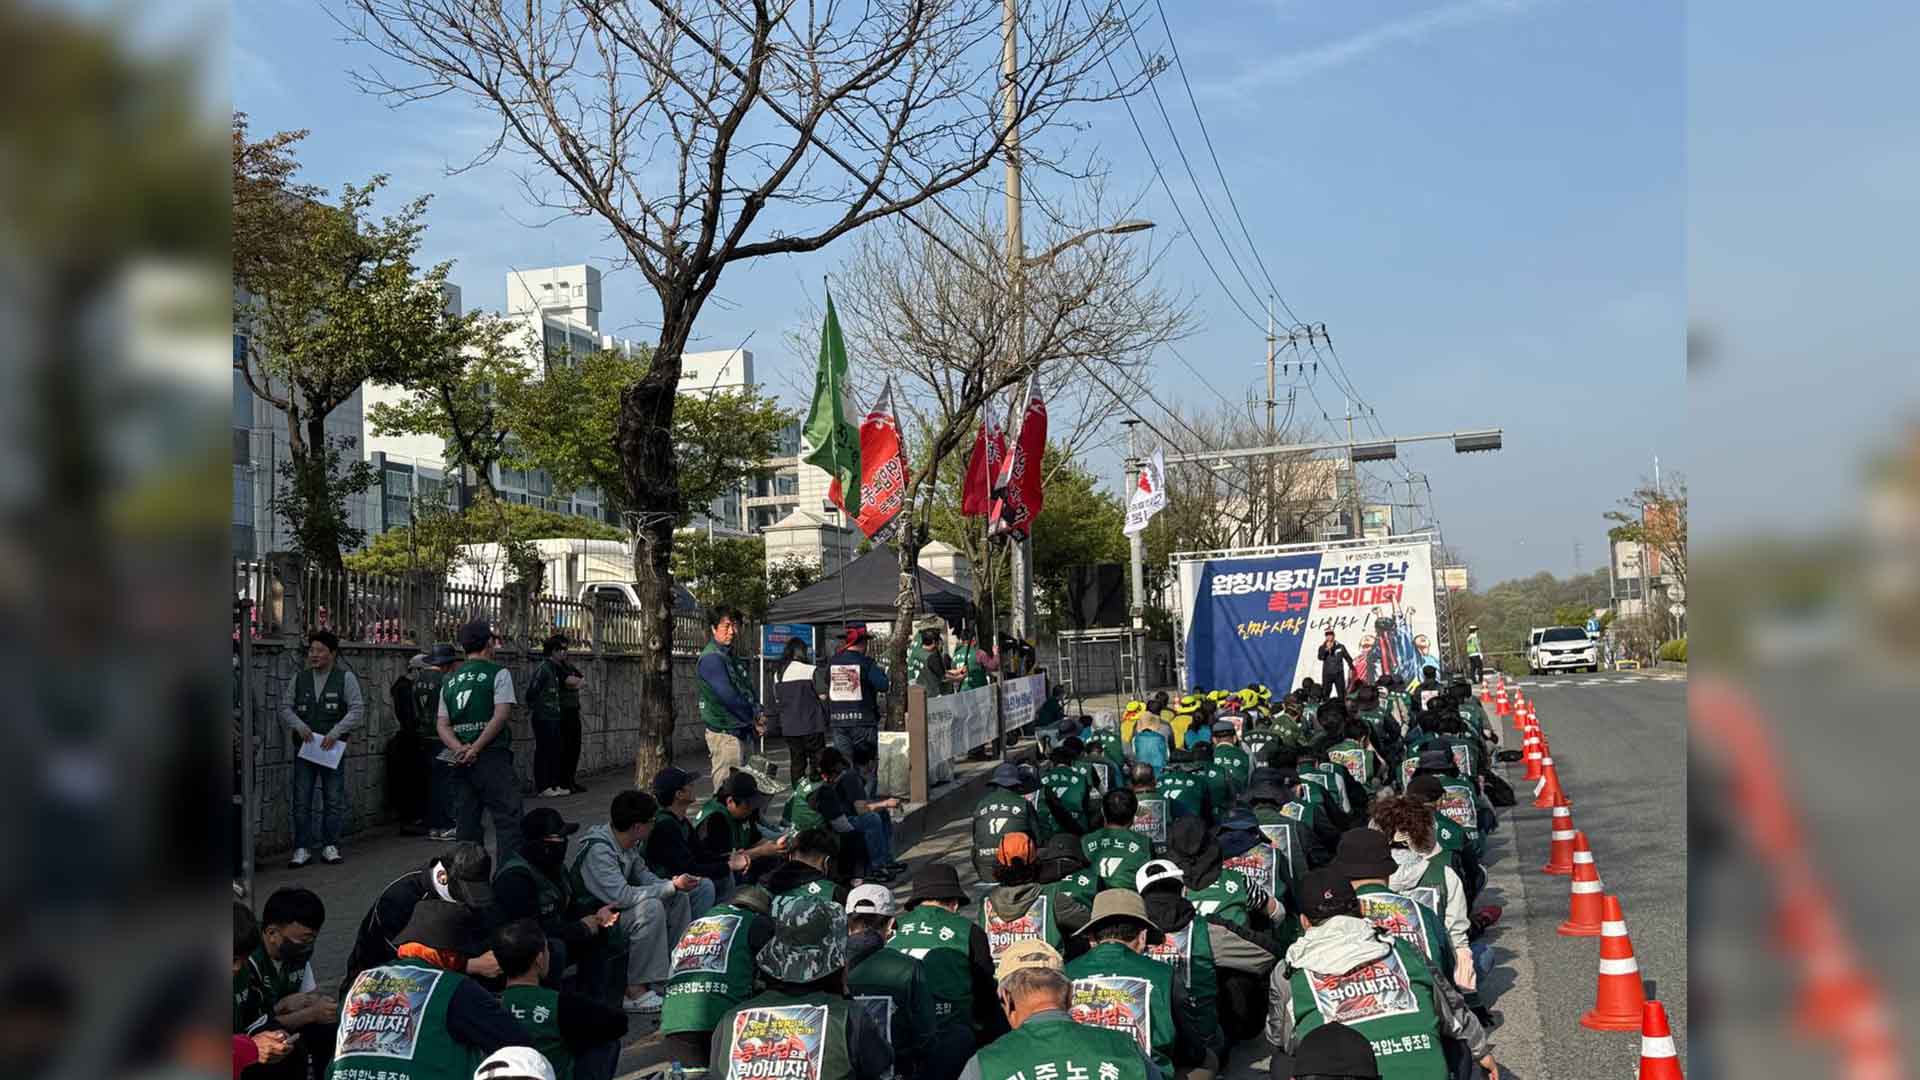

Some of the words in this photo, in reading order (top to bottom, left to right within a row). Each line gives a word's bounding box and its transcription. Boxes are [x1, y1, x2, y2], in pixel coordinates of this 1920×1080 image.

[1211, 568, 1315, 596] 원청사용자
[1319, 564, 1361, 587] 교섭
[1365, 560, 1409, 585] 응낙
[1267, 590, 1309, 613] 촉구
[1318, 583, 1403, 609] 결의대회
[1237, 620, 1270, 640] 진짜
[1270, 616, 1305, 635] 사장
